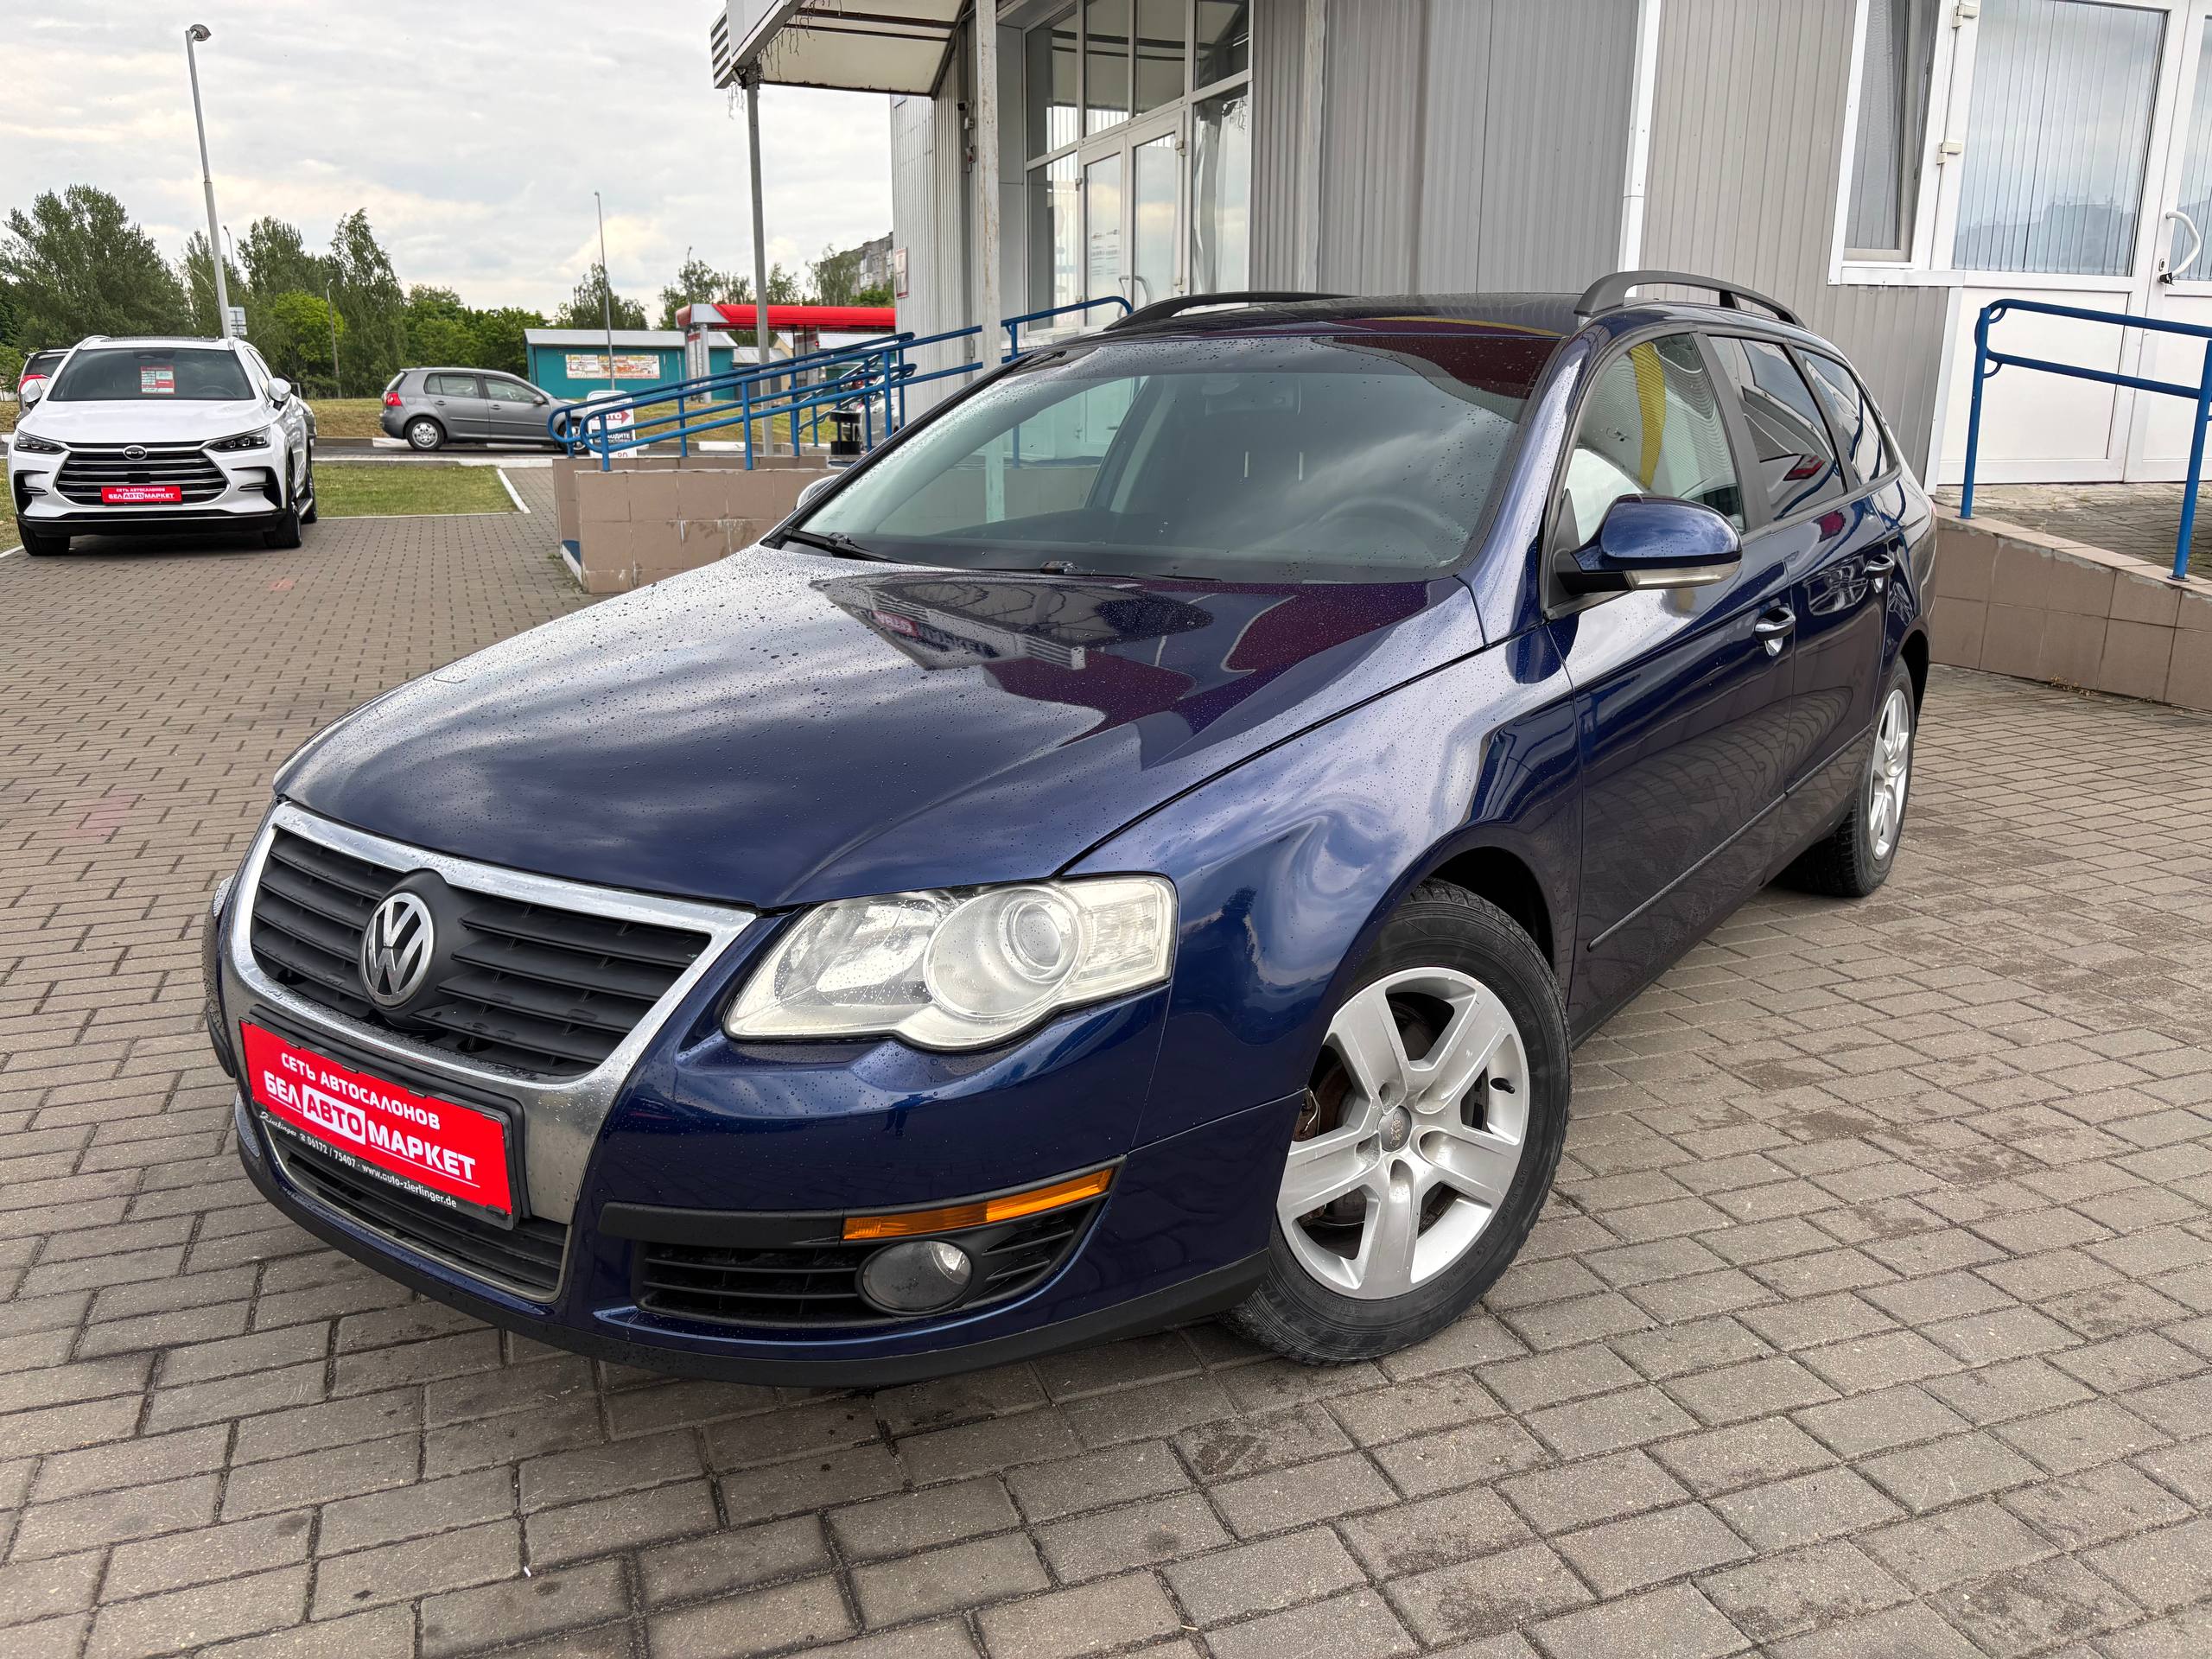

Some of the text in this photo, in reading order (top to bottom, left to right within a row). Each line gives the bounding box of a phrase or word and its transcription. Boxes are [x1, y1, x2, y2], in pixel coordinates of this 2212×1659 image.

[281, 1052, 441, 1130] СЕТЬ АВТОСАЛОНОВ
[307, 1135, 328, 1154] 06172
[334, 1149, 356, 1168] 75407
[361, 1163, 457, 1209] www.auto-zierlinger.de
